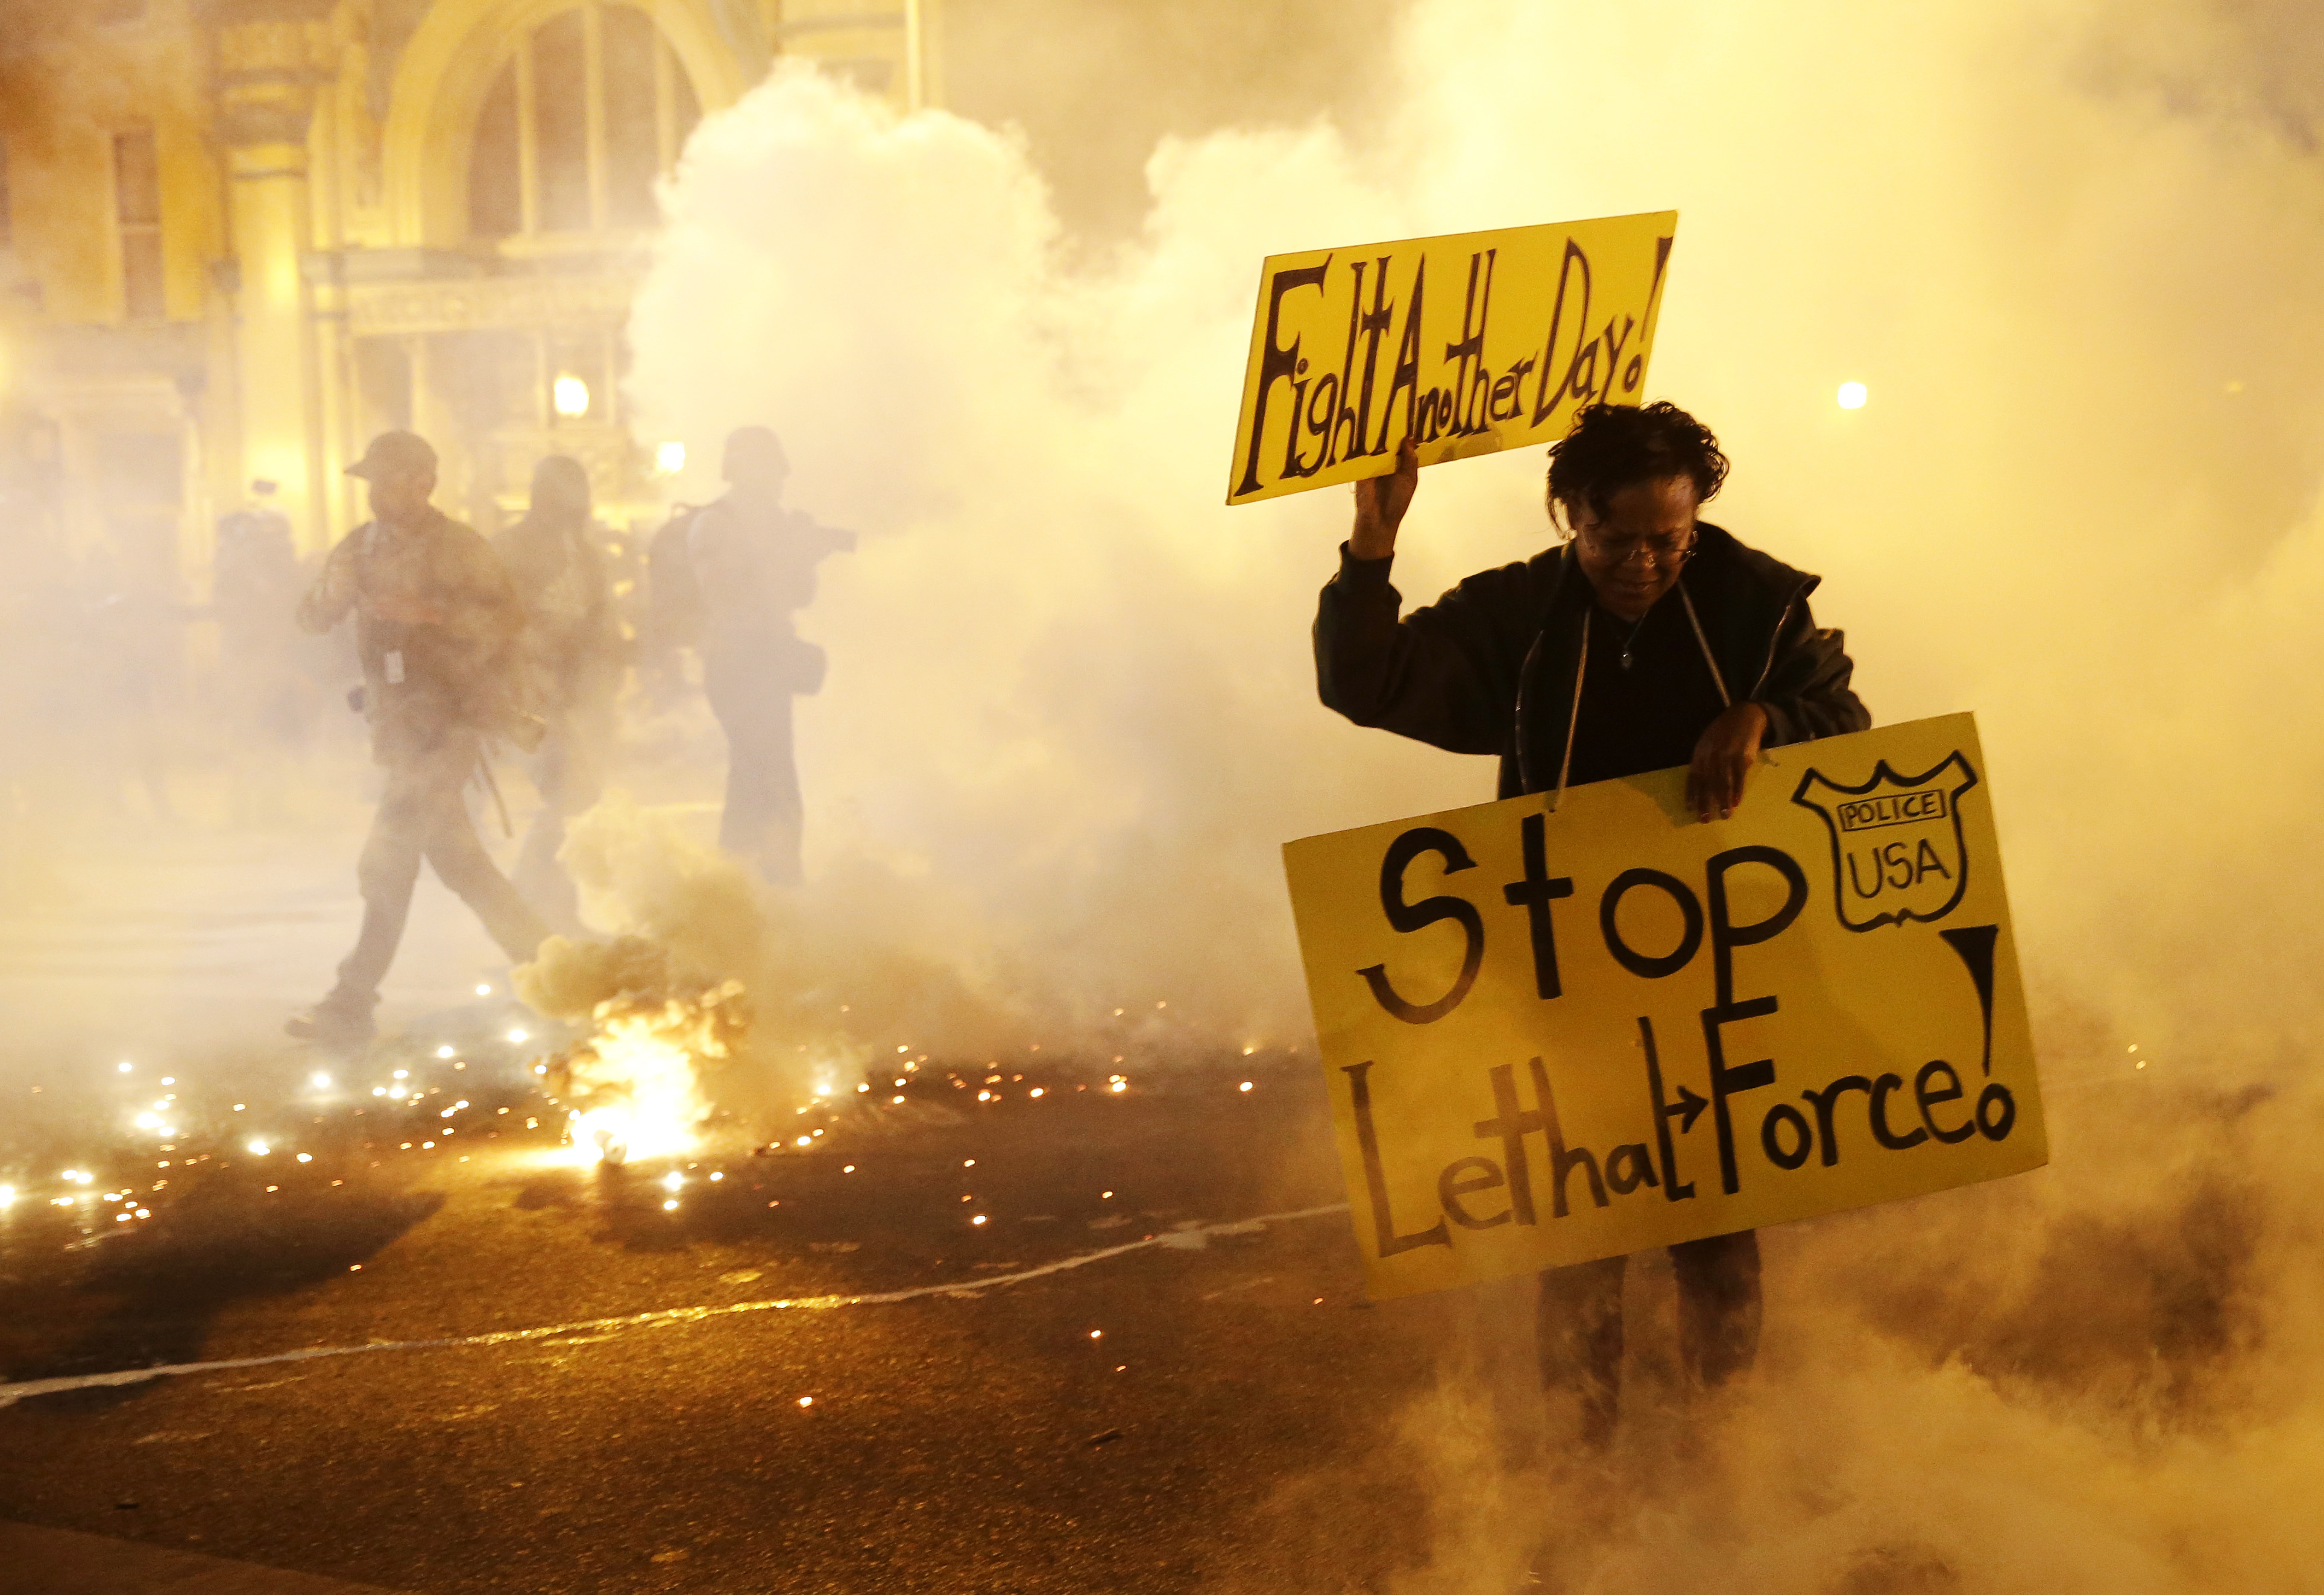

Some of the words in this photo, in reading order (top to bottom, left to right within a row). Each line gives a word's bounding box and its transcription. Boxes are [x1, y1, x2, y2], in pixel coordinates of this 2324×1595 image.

[1235, 252, 1396, 497] Fight
[1370, 248, 1538, 456] Another
[1529, 236, 1674, 428] Day!
[1844, 792, 1939, 826] POLICE
[1848, 838, 1951, 899] USA
[1355, 812, 1809, 1025] Stop
[1340, 1016, 1695, 1259] Lethal
[1700, 924, 2017, 1196] Force!
